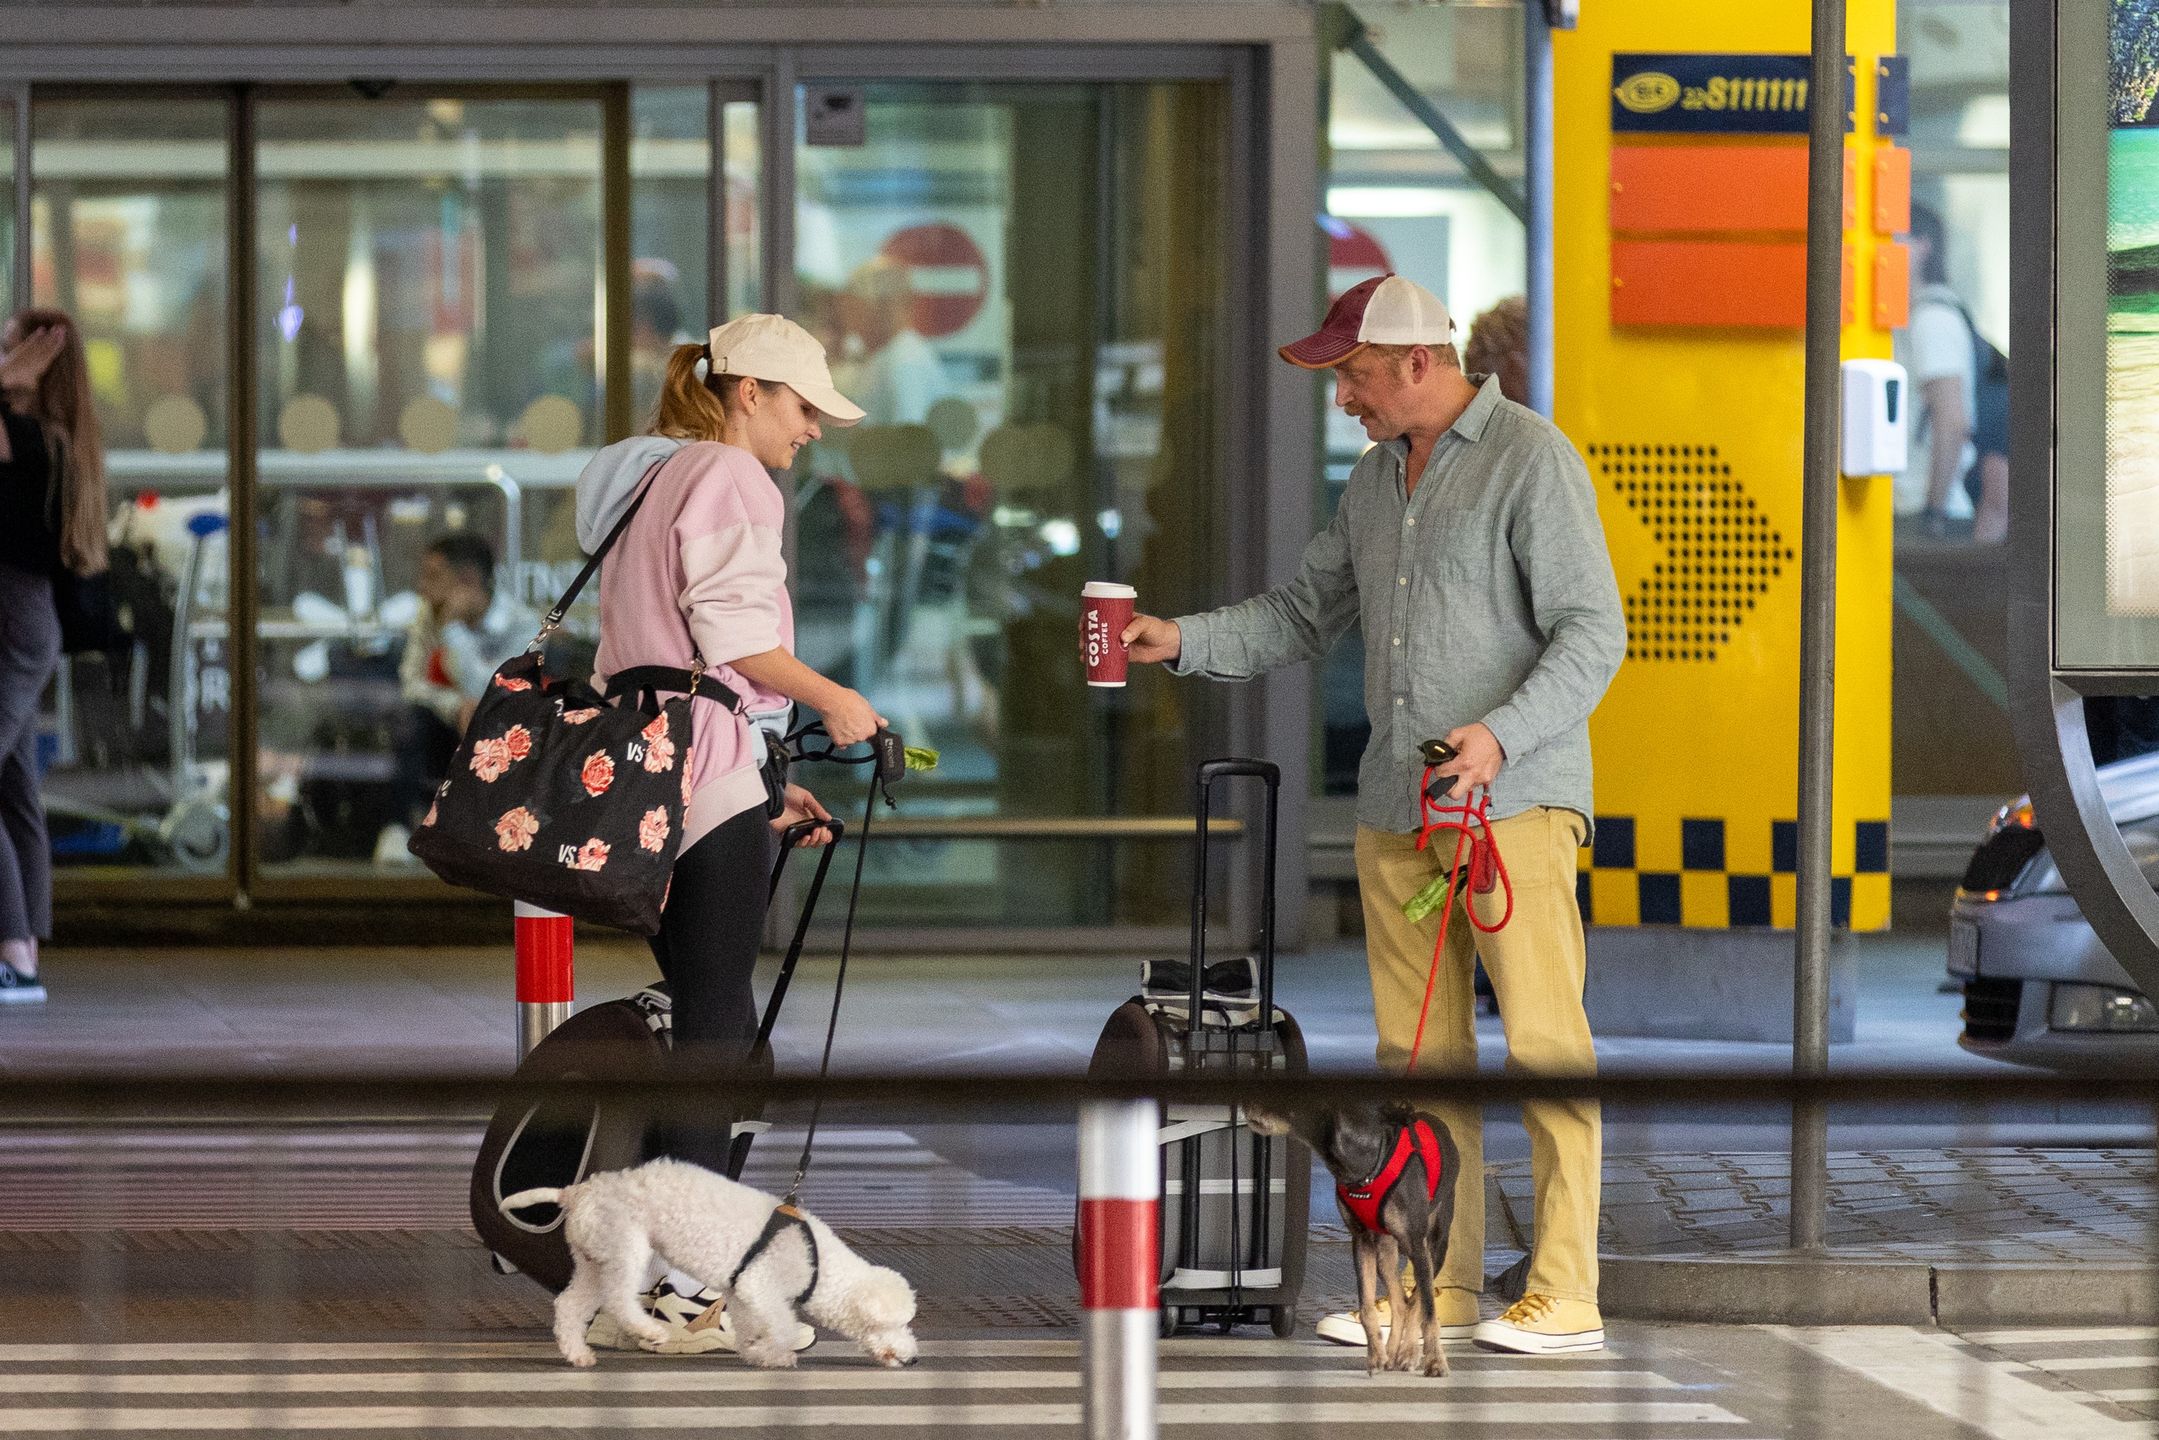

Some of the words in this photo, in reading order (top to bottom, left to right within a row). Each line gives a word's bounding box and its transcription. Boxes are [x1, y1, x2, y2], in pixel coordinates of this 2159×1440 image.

[1088, 609, 1100, 667] COSTA
[1101, 622, 1109, 655] COFFEE
[627, 742, 645, 762] VS
[558, 844, 577, 864] VS
